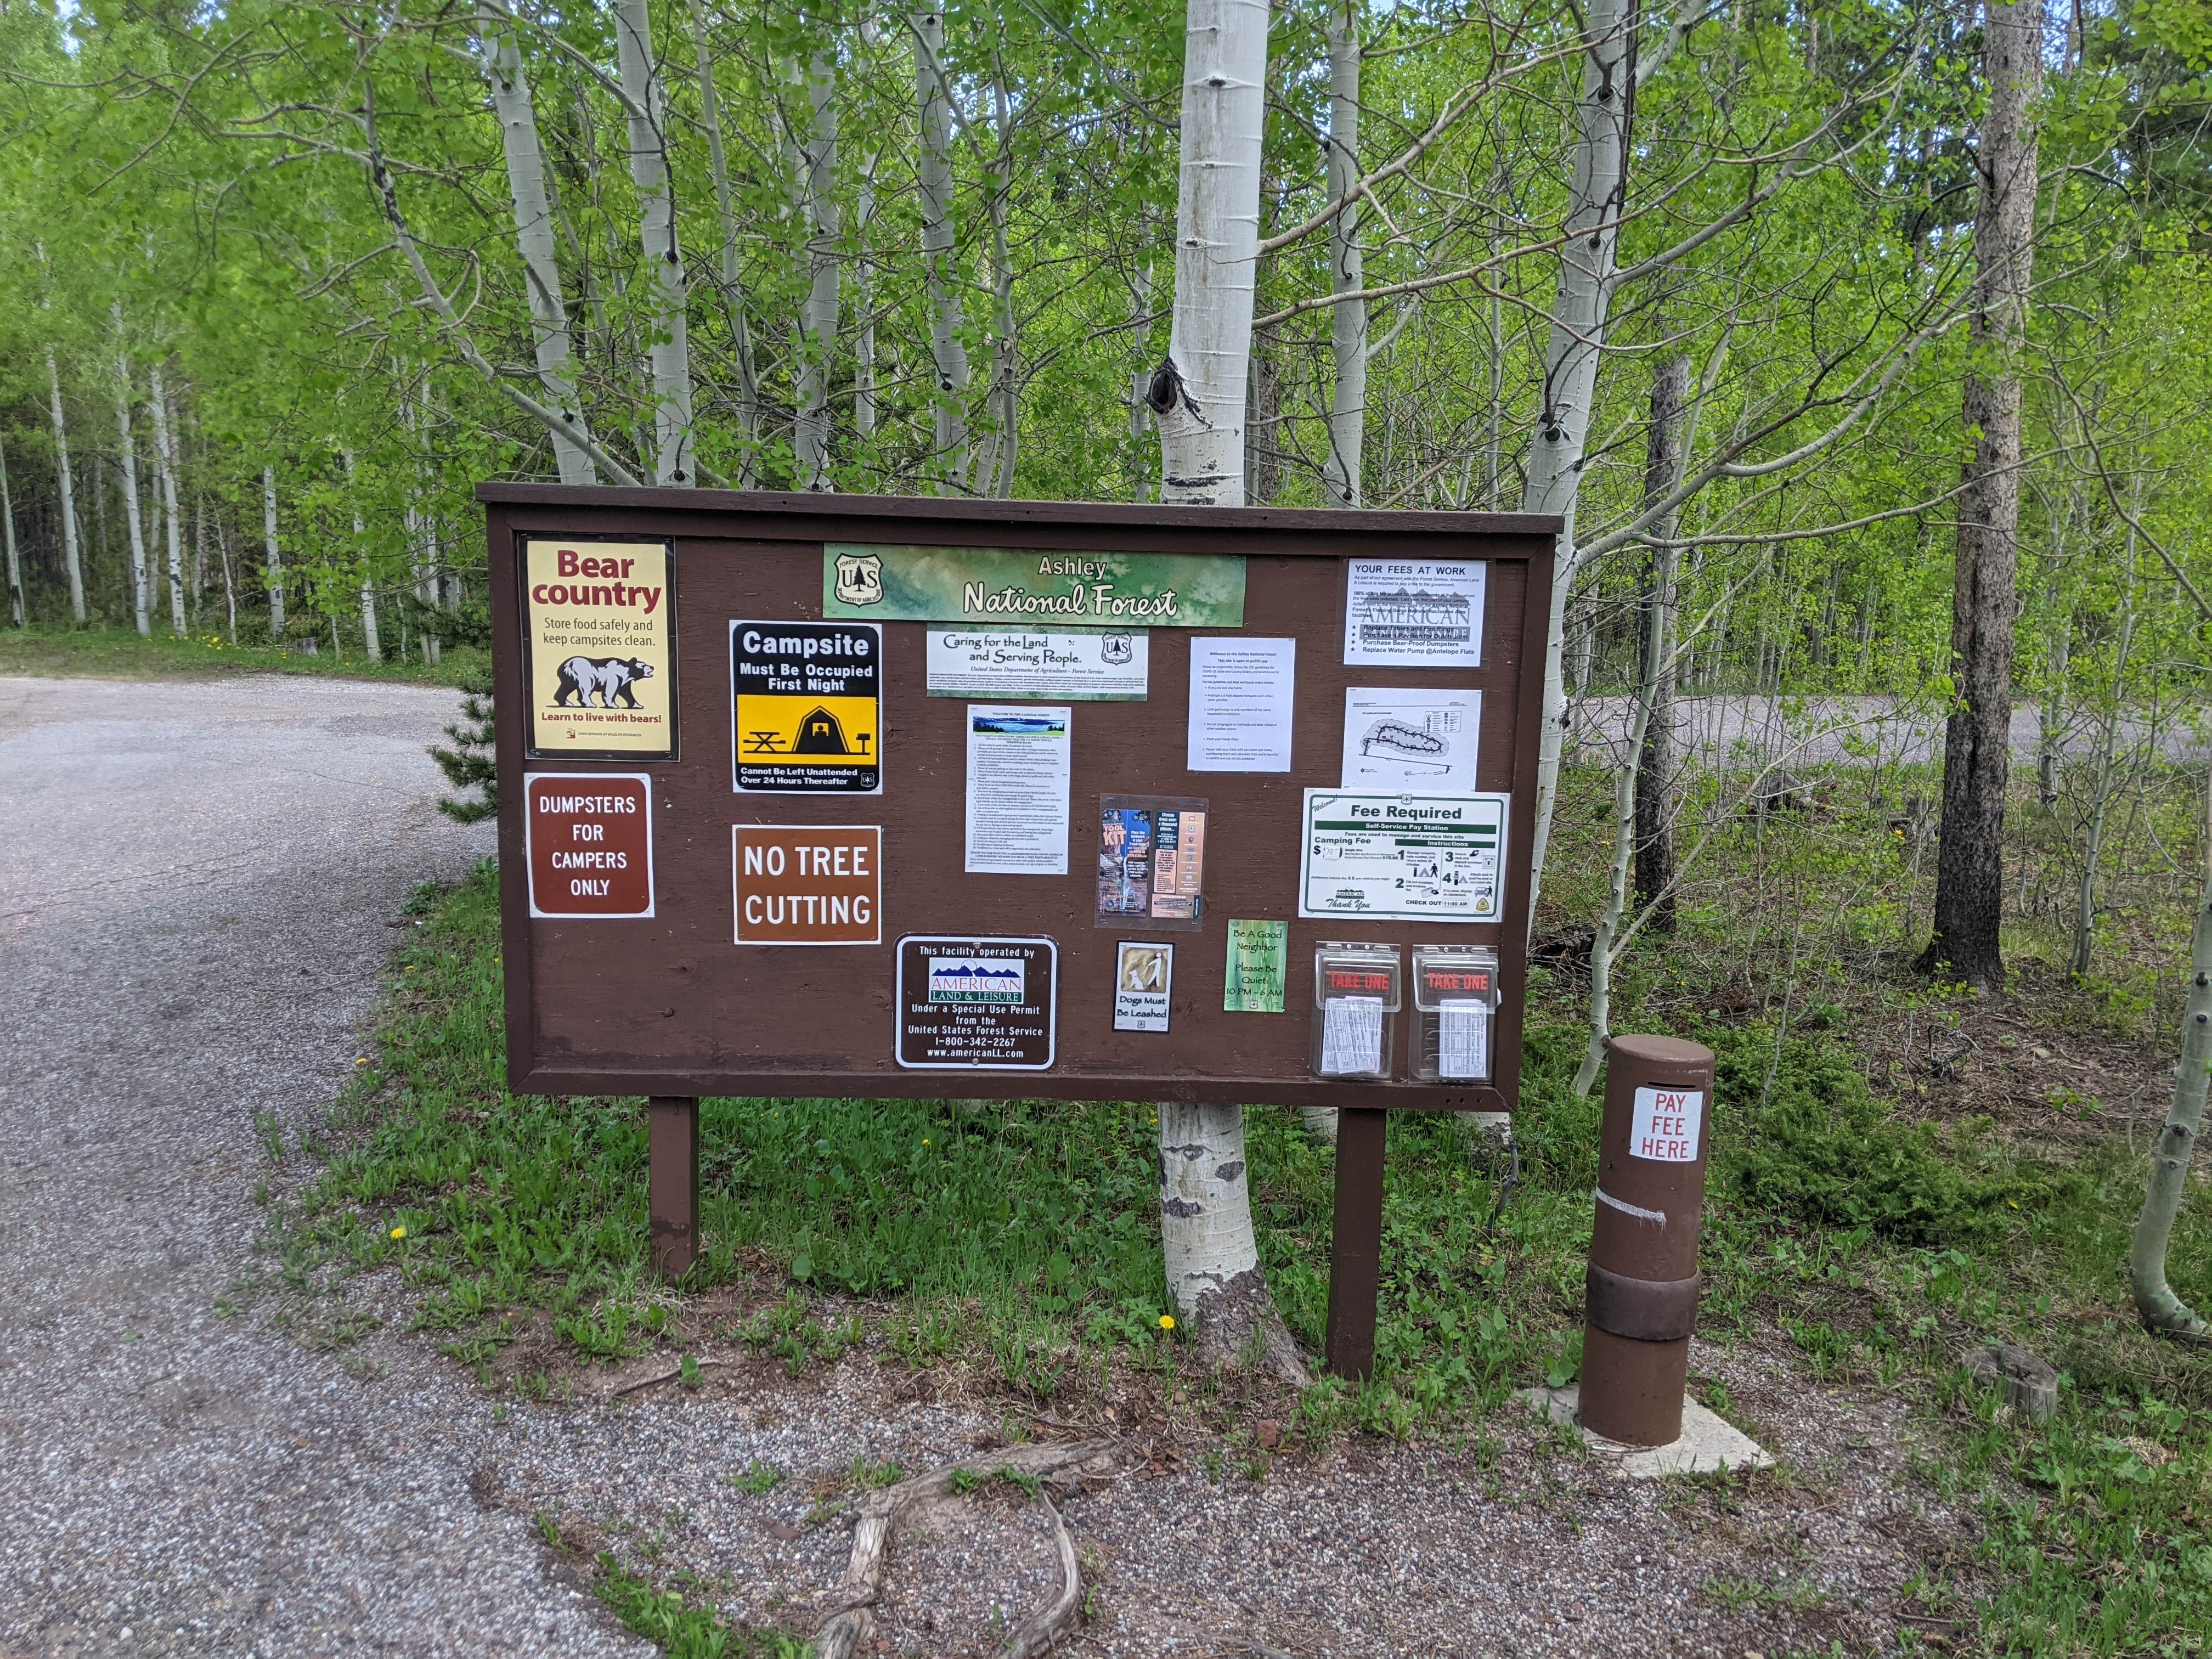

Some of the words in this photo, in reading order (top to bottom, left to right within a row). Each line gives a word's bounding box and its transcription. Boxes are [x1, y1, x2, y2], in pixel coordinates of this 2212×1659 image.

[557, 550, 635, 578] Bear
[840, 560, 857, 568] FOREST
[859, 560, 878, 569] SERVICE
[1037, 556, 1107, 580] Ashley
[1355, 565, 1382, 573] YOUR
[1388, 566, 1412, 574] FEES
[1436, 567, 1465, 575] WORK
[532, 582, 662, 615] country
[963, 582, 1087, 615] National
[1091, 584, 1178, 617] Forest
[544, 617, 571, 630] Store
[574, 618, 596, 630] food
[600, 619, 630, 633] safely
[633, 619, 652, 630] and
[543, 633, 567, 646] keep
[570, 634, 621, 647] campsites
[625, 634, 656, 646] clean.
[743, 631, 869, 658] Campsite
[944, 634, 981, 650] Caring
[984, 635, 1001, 646] for
[1004, 635, 1021, 647] the
[1023, 635, 1048, 649] Land
[969, 650, 989, 661] and
[993, 650, 1039, 665] Serving
[1043, 650, 1082, 667] People.
[740, 663, 774, 675] Must
[781, 664, 799, 675] Be
[805, 664, 872, 678] Occupied
[769, 678, 802, 690] First
[808, 679, 844, 693] Night
[541, 712, 571, 721] Learn
[585, 713, 603, 722] live
[606, 713, 628, 722] with
[630, 714, 662, 723] bears!
[540, 796, 635, 813] DUMPSTERS
[1312, 794, 1338, 812] Welcome!
[1351, 805, 1380, 817] Fee
[1386, 806, 1462, 821] Required
[573, 825, 603, 840] FOR
[1103, 830, 1126, 845] KIT
[1314, 837, 1352, 845] Camping
[1313, 845, 1321, 855] $
[1398, 849, 1404, 860] 1
[1445, 851, 1453, 862] 3
[552, 852, 627, 868] CAMPERS
[745, 846, 785, 876] NO
[795, 847, 869, 876] TREE
[1395, 878, 1404, 888] 2
[1442, 873, 1452, 883] 4
[571, 879, 610, 895] ONLY
[745, 895, 870, 924] CUTTING
[1326, 899, 1352, 908] Thank
[1354, 900, 1370, 911] You
[919, 946, 937, 955] This
[942, 946, 975, 957] facility
[980, 948, 1019, 958] operated
[1024, 949, 1035, 959] by
[1237, 941, 1278, 953] Neighbor
[931, 977, 1021, 991] AMERICAN
[1329, 972, 1361, 988] TAKE
[1364, 973, 1390, 990] ONE
[1428, 973, 1459, 989] TAKE
[1463, 974, 1488, 991] ONE
[933, 991, 961, 1001] LAND
[964, 992, 973, 1001] &
[978, 992, 1018, 1001] LEISURE
[1119, 996, 1142, 1006] Dogs
[1144, 997, 1165, 1005] Must
[912, 1004, 938, 1013] Under
[952, 1004, 985, 1014] Special
[990, 1005, 1006, 1014] Use
[1011, 1006, 1040, 1015] Permit
[1131, 1009, 1166, 1018] Leashed
[956, 1016, 976, 1025] from
[981, 1016, 996, 1025] the
[908, 1025, 937, 1034] United
[941, 1026, 972, 1034] States
[977, 1026, 1005, 1035] Forest
[1009, 1027, 1042, 1036] Service
[935, 1037, 1015, 1047] 1-800-342-2267
[927, 1048, 1023, 1058] www.americanLL.com
[1655, 1093, 1686, 1113] PAY
[1651, 1116, 1686, 1135] FEE
[1641, 1137, 1689, 1159] HERE
